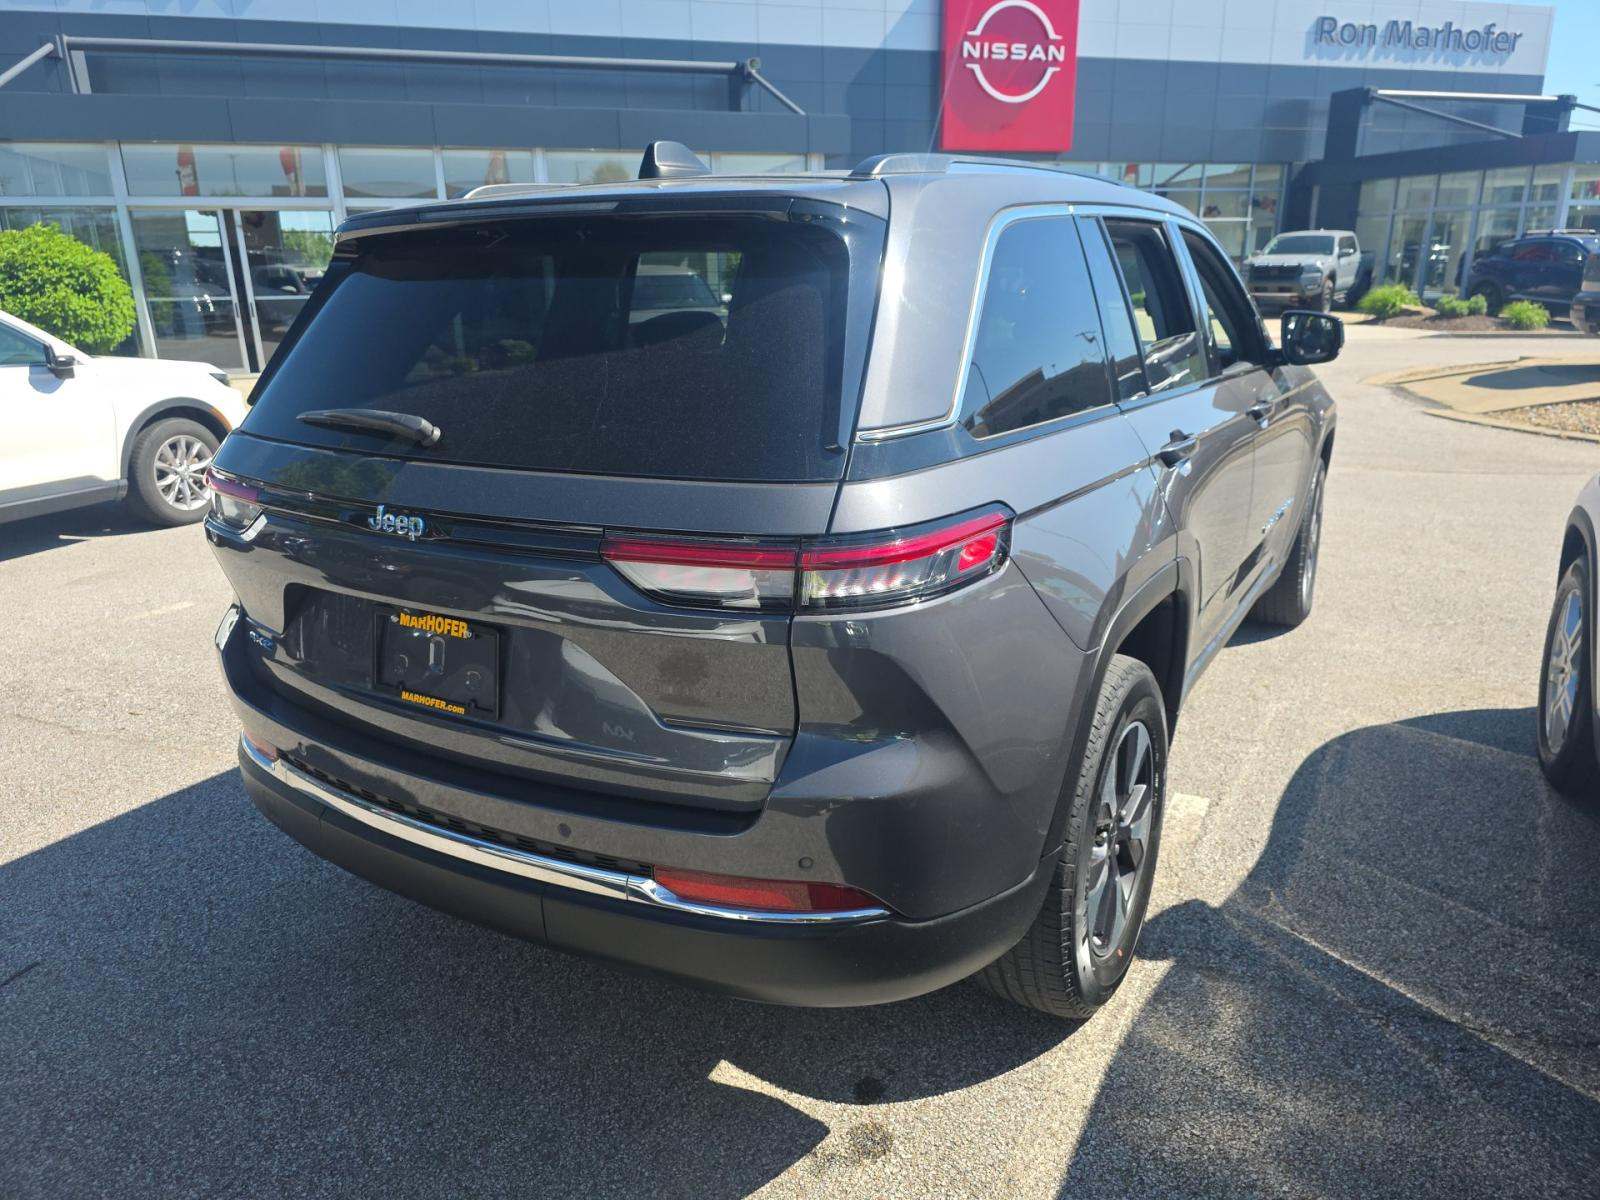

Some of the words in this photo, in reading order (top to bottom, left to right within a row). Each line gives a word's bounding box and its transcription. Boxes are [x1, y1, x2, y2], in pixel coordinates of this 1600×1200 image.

[1317, 16, 1378, 47] Ron
[1386, 20, 1523, 53] Marhofer
[962, 40, 1065, 62] NISSAN
[367, 504, 424, 541] Jeep
[399, 612, 469, 638] MARHOFER
[401, 690, 465, 715] MARHOFER.com
